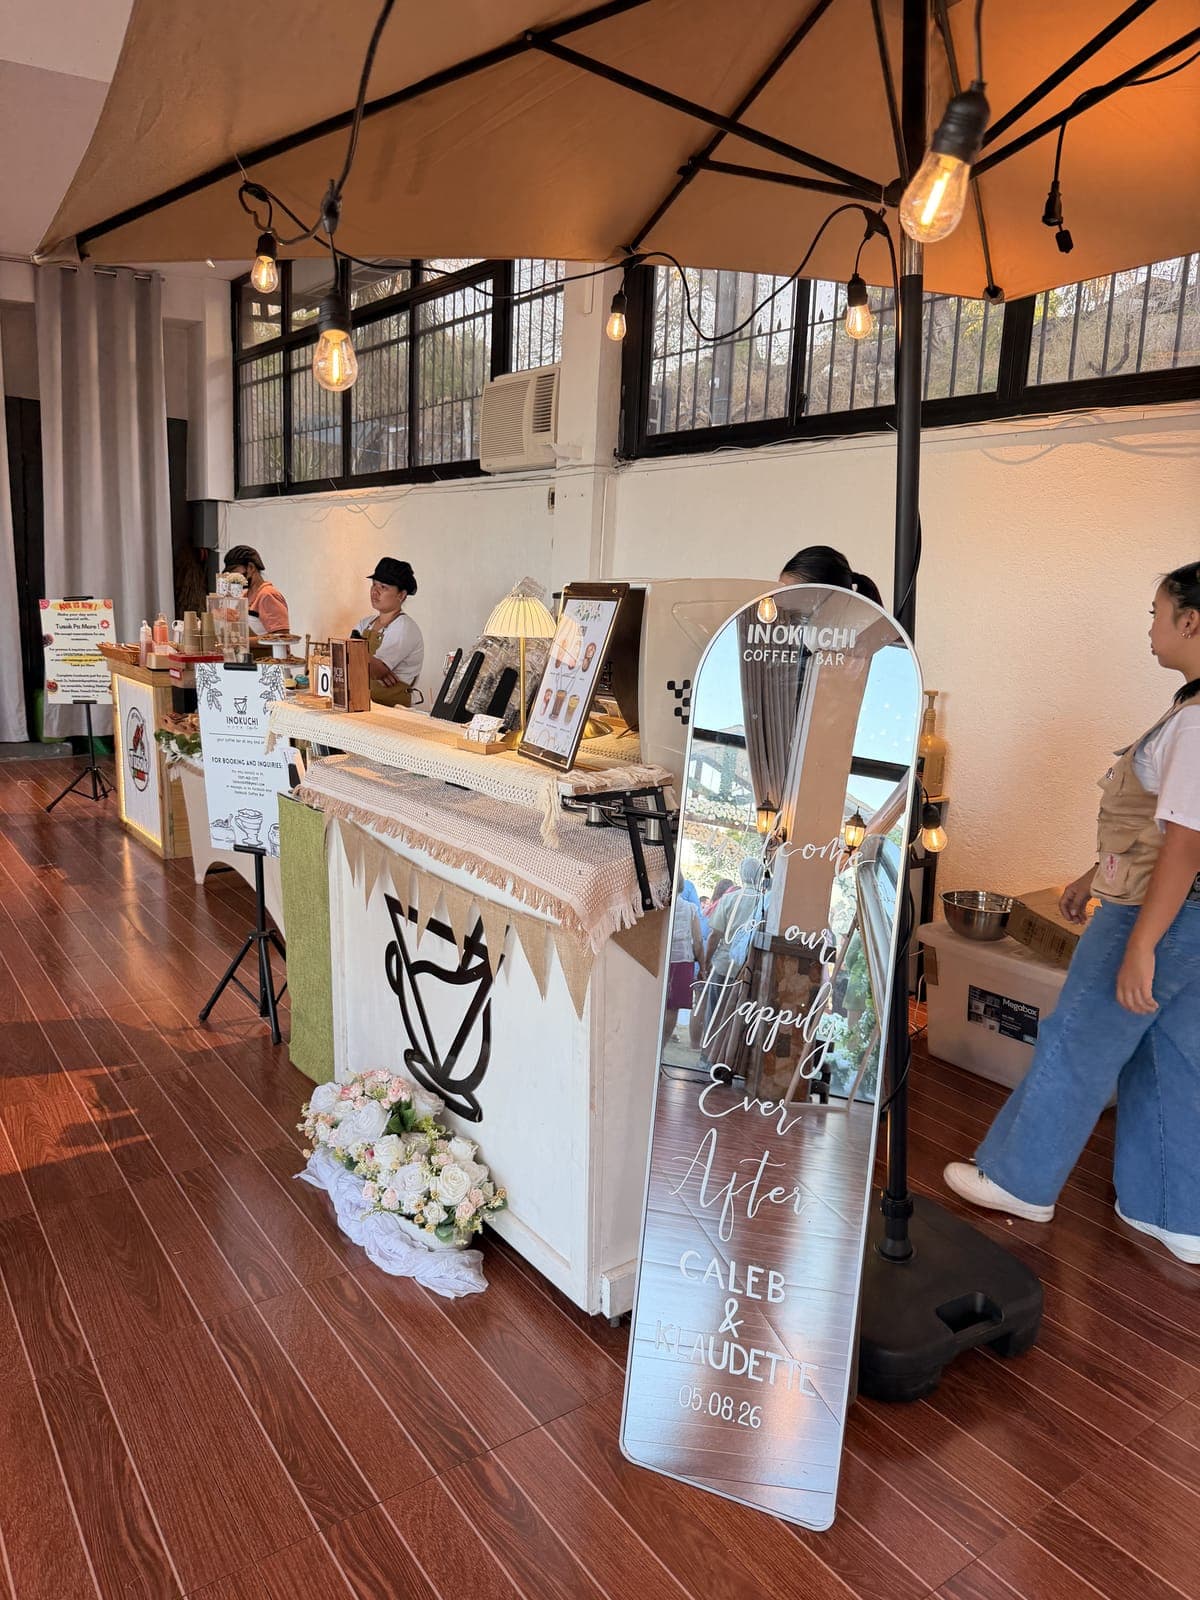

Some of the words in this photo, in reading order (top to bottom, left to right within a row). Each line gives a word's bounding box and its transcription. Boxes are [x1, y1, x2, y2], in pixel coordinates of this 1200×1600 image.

[747, 624, 857, 649] INOKUCHI
[743, 649, 798, 664] COFFEE
[816, 652, 845, 666] BAR
[321, 673, 329, 692] 0
[226, 716, 259, 726] INOKUCHI
[222, 757, 245, 766] BOOKING
[246, 759, 257, 767] AND
[784, 924, 837, 965] our
[689, 959, 838, 1079] Happily
[1002, 998, 1037, 1017] Megabox
[698, 1062, 802, 1136] Ever
[668, 1127, 813, 1242] After
[679, 1250, 786, 1304] CALEB
[718, 1297, 744, 1338] &
[655, 1319, 820, 1397] KLAUDETTE
[679, 1384, 763, 1429] 05.08.26
